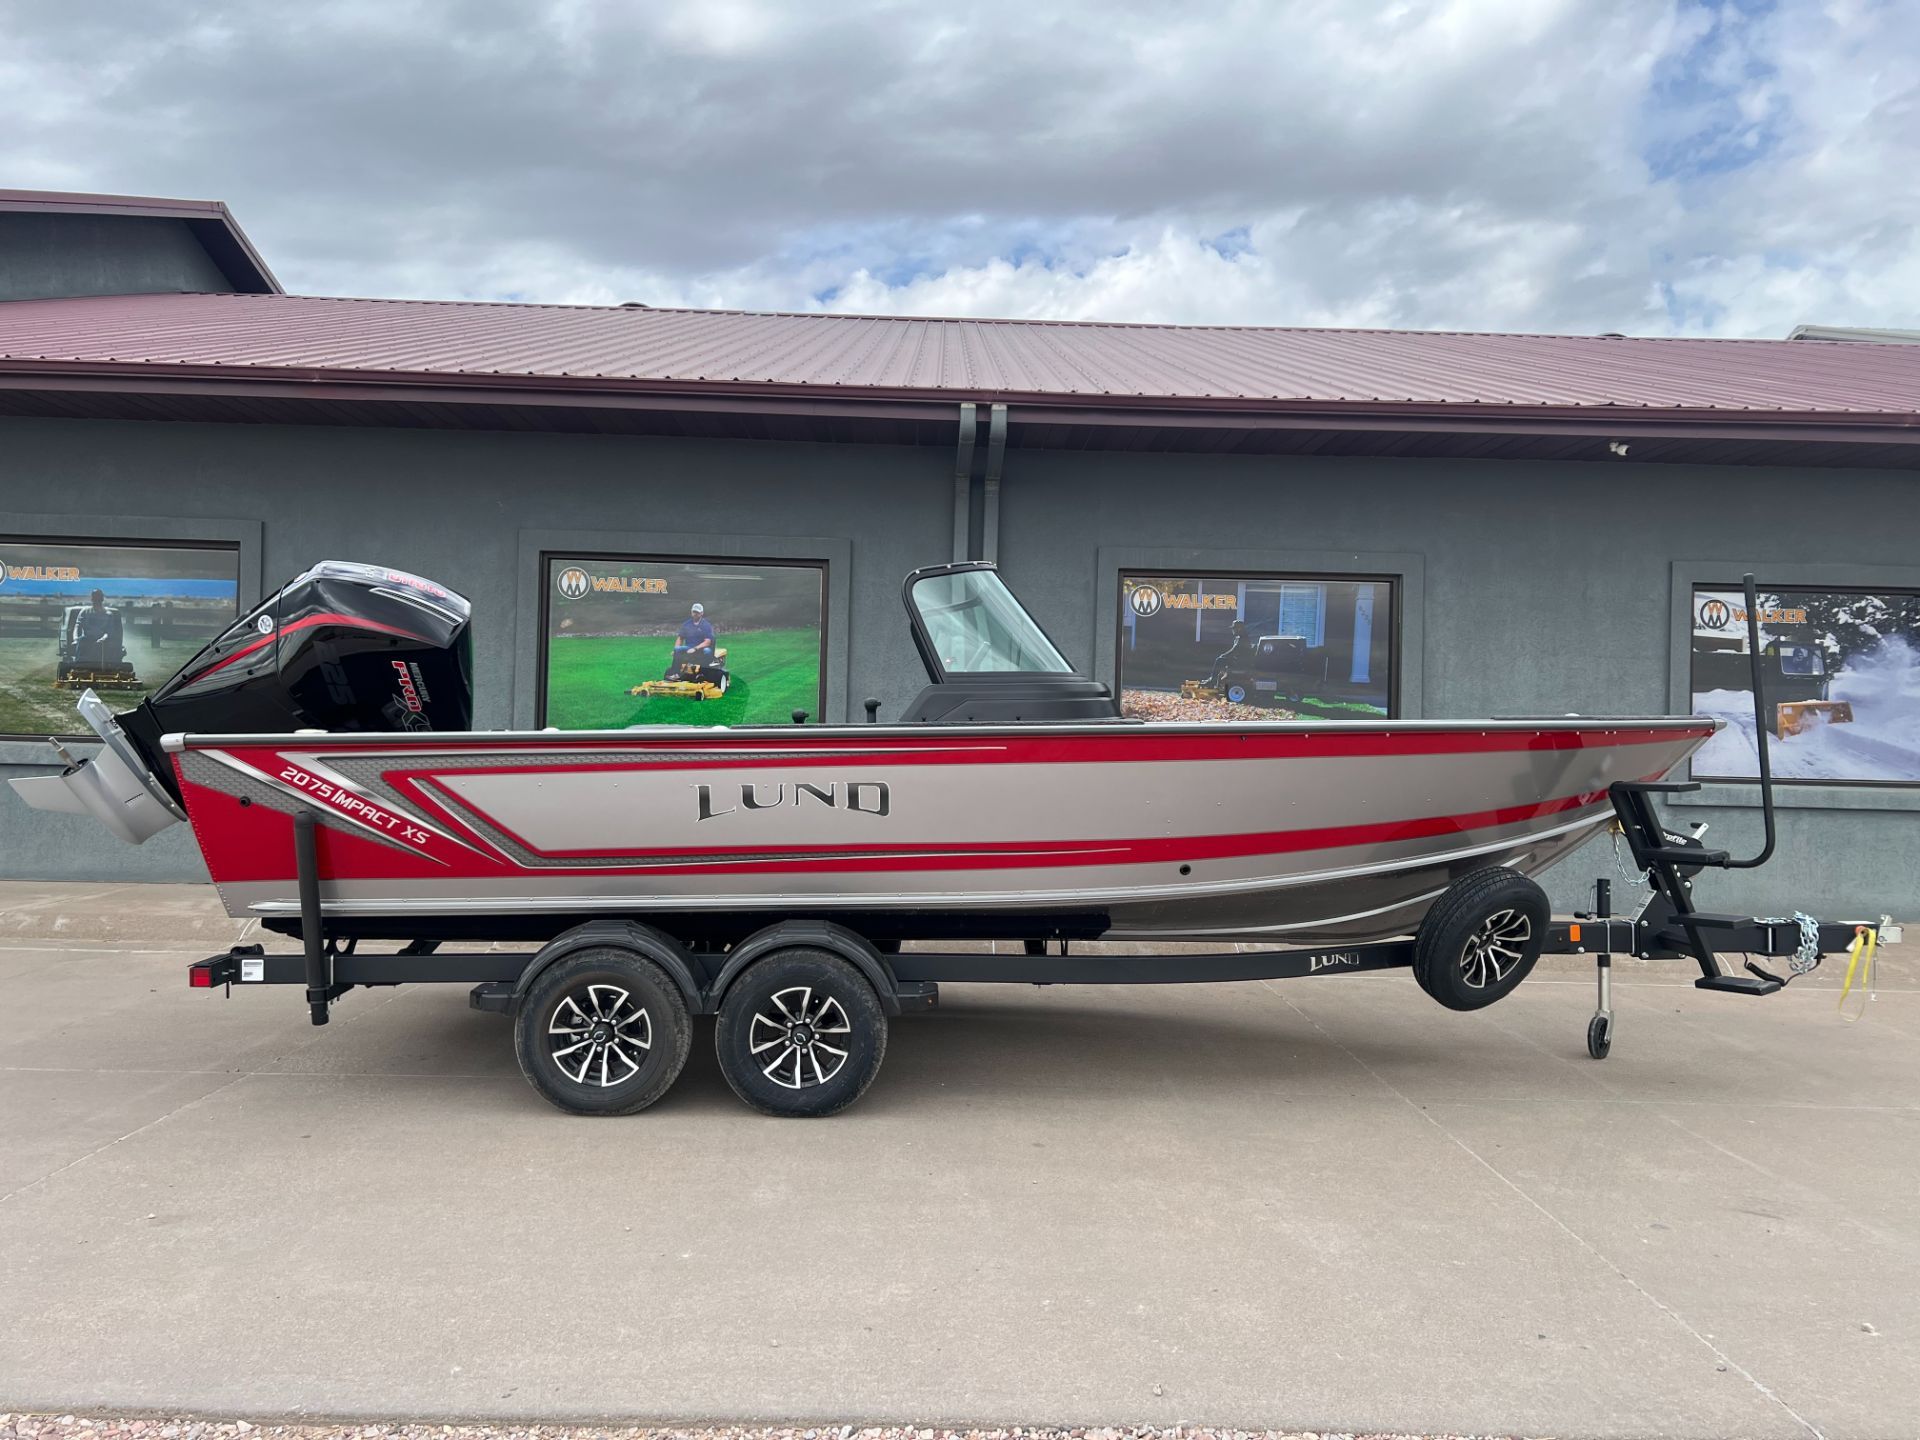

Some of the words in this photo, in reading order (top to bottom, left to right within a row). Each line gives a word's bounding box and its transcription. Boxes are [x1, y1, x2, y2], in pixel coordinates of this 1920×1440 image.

[7, 566, 80, 581] WALKER
[590, 576, 668, 594] WALKER
[1161, 592, 1237, 609] WALKER
[391, 660, 423, 713] PRO
[280, 766, 334, 798] 2075
[331, 789, 401, 829] IMPACT
[400, 825, 431, 845] XS
[689, 781, 890, 823] LUND
